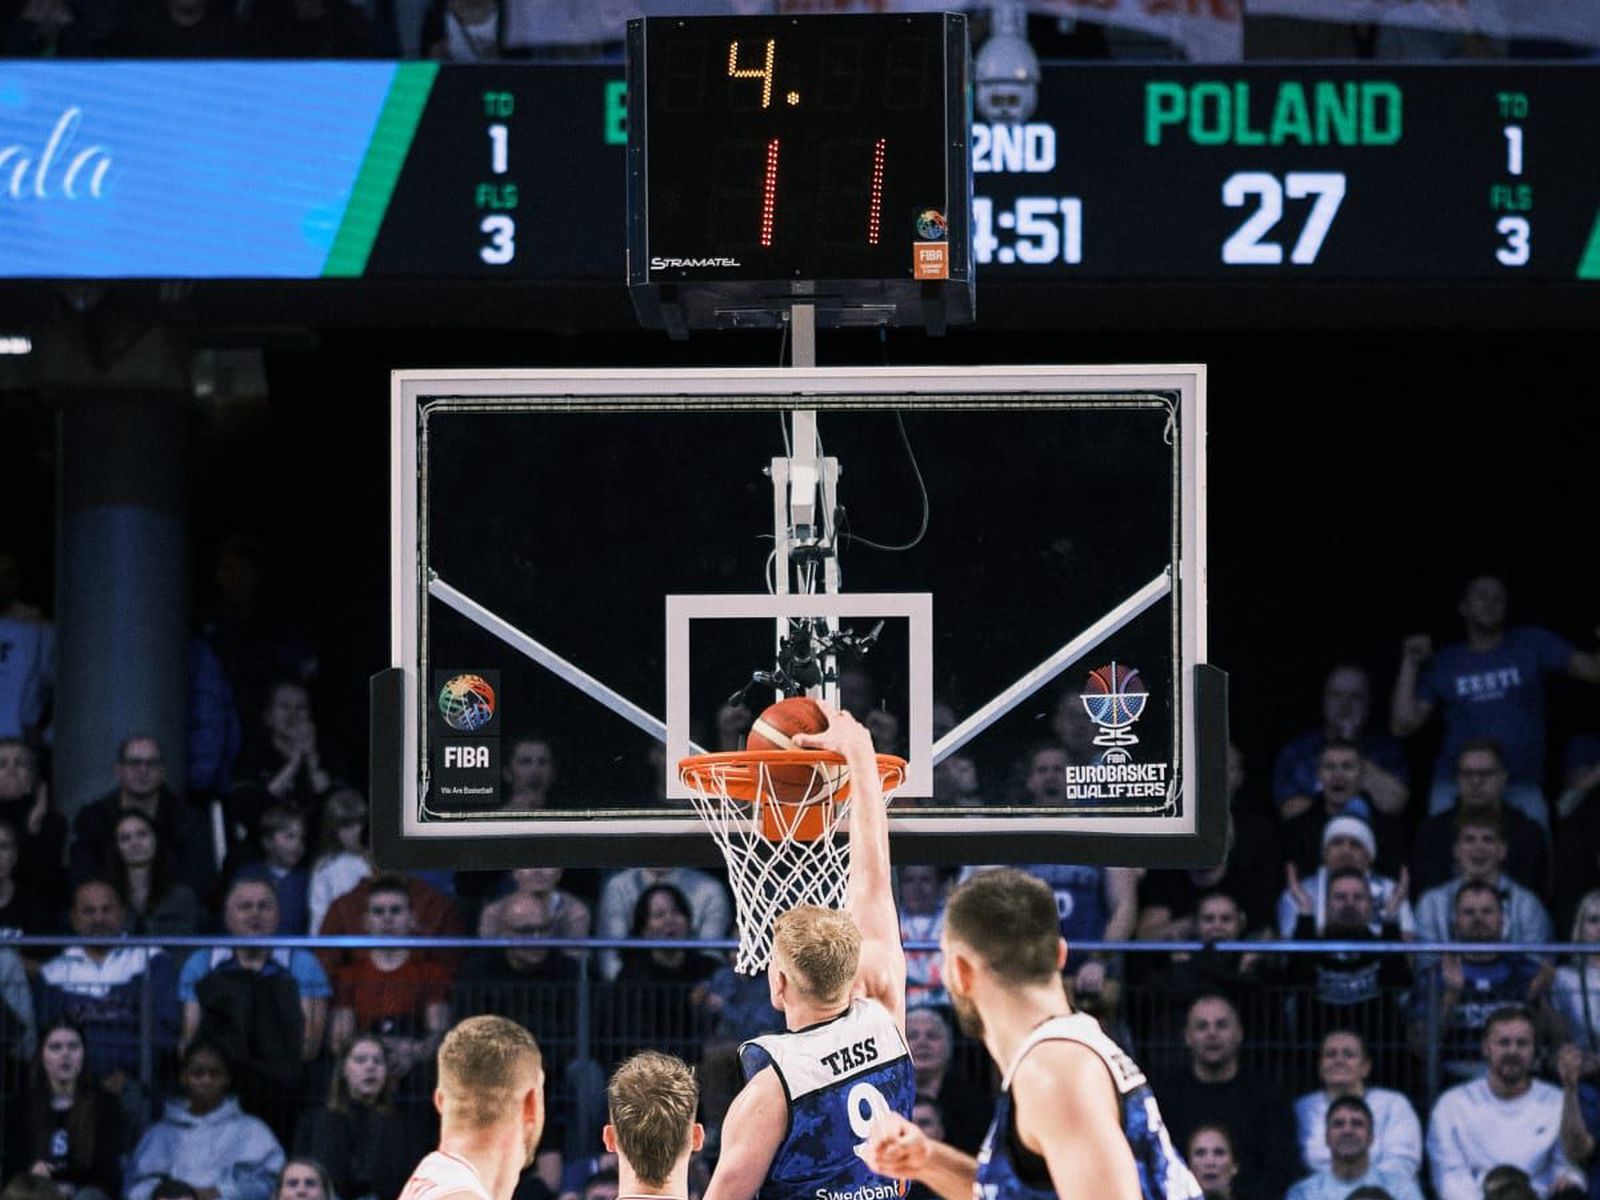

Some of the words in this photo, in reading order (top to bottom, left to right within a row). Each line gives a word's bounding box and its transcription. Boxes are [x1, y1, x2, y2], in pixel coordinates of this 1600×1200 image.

[1145, 81, 1402, 146] POLAND
[488, 124, 508, 174] 1
[972, 122, 1056, 173] 2ND
[1503, 125, 1523, 175] 1
[480, 214, 516, 265] 3
[973, 197, 1082, 265] 4:51
[1221, 172, 1347, 265] 27
[1496, 215, 1531, 267] 3
[650, 257, 741, 271] STRAMATEL
[444, 746, 490, 769] FIBA
[1066, 763, 1168, 784] EUROBASKET
[1107, 754, 1126, 764] FIBA
[1066, 783, 1165, 800] QUALIFIERS
[820, 1037, 879, 1076] TASS
